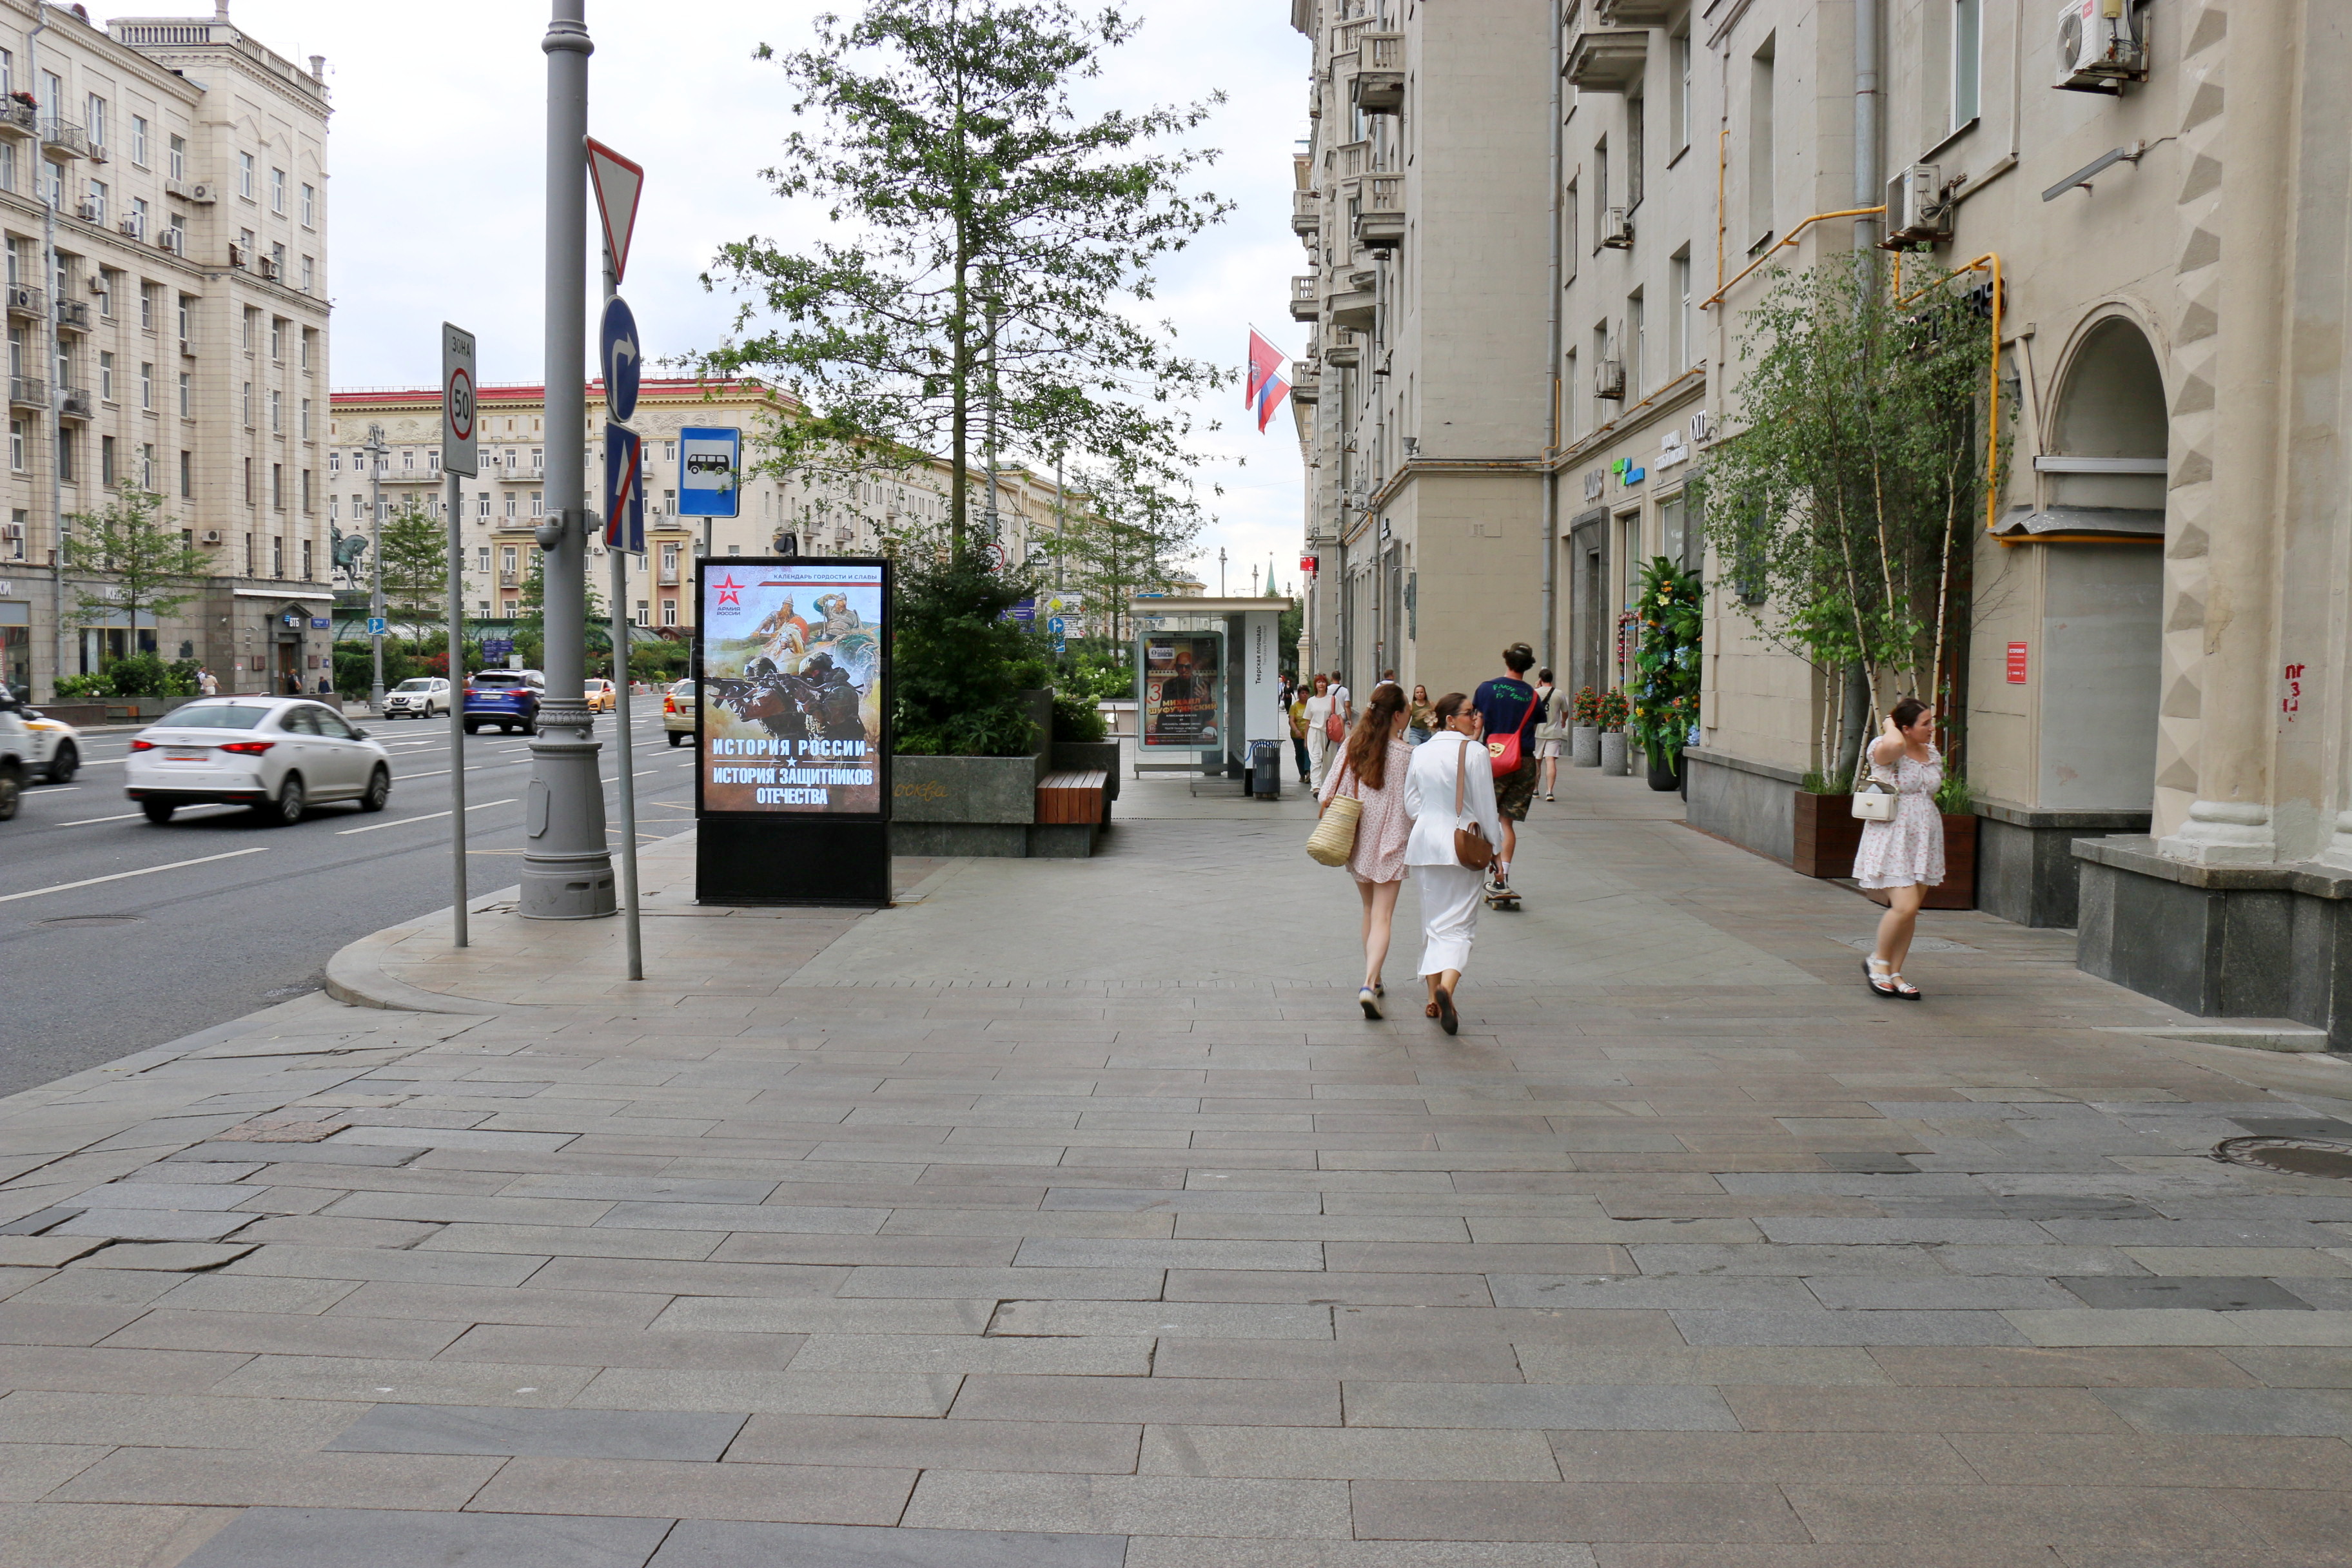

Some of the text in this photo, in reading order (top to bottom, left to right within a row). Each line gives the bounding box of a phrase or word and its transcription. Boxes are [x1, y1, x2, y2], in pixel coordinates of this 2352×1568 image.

[452, 337, 471, 358] ЗОНА
[455, 389, 469, 420] 50
[289, 617, 299, 627] ВТБ
[1150, 684, 1161, 701] 3
[1148, 701, 1217, 715] ШУФУТИНСКИЙ
[1162, 698, 1201, 707] МИХАИЛ
[712, 738, 790, 756] ИСТОРИЯ
[713, 767, 873, 787] ИСТОРИЯ ЗАЩИТНИКОВ
[756, 787, 828, 805] ОТЕЧЕСТВА
[892, 779, 949, 802] осква
